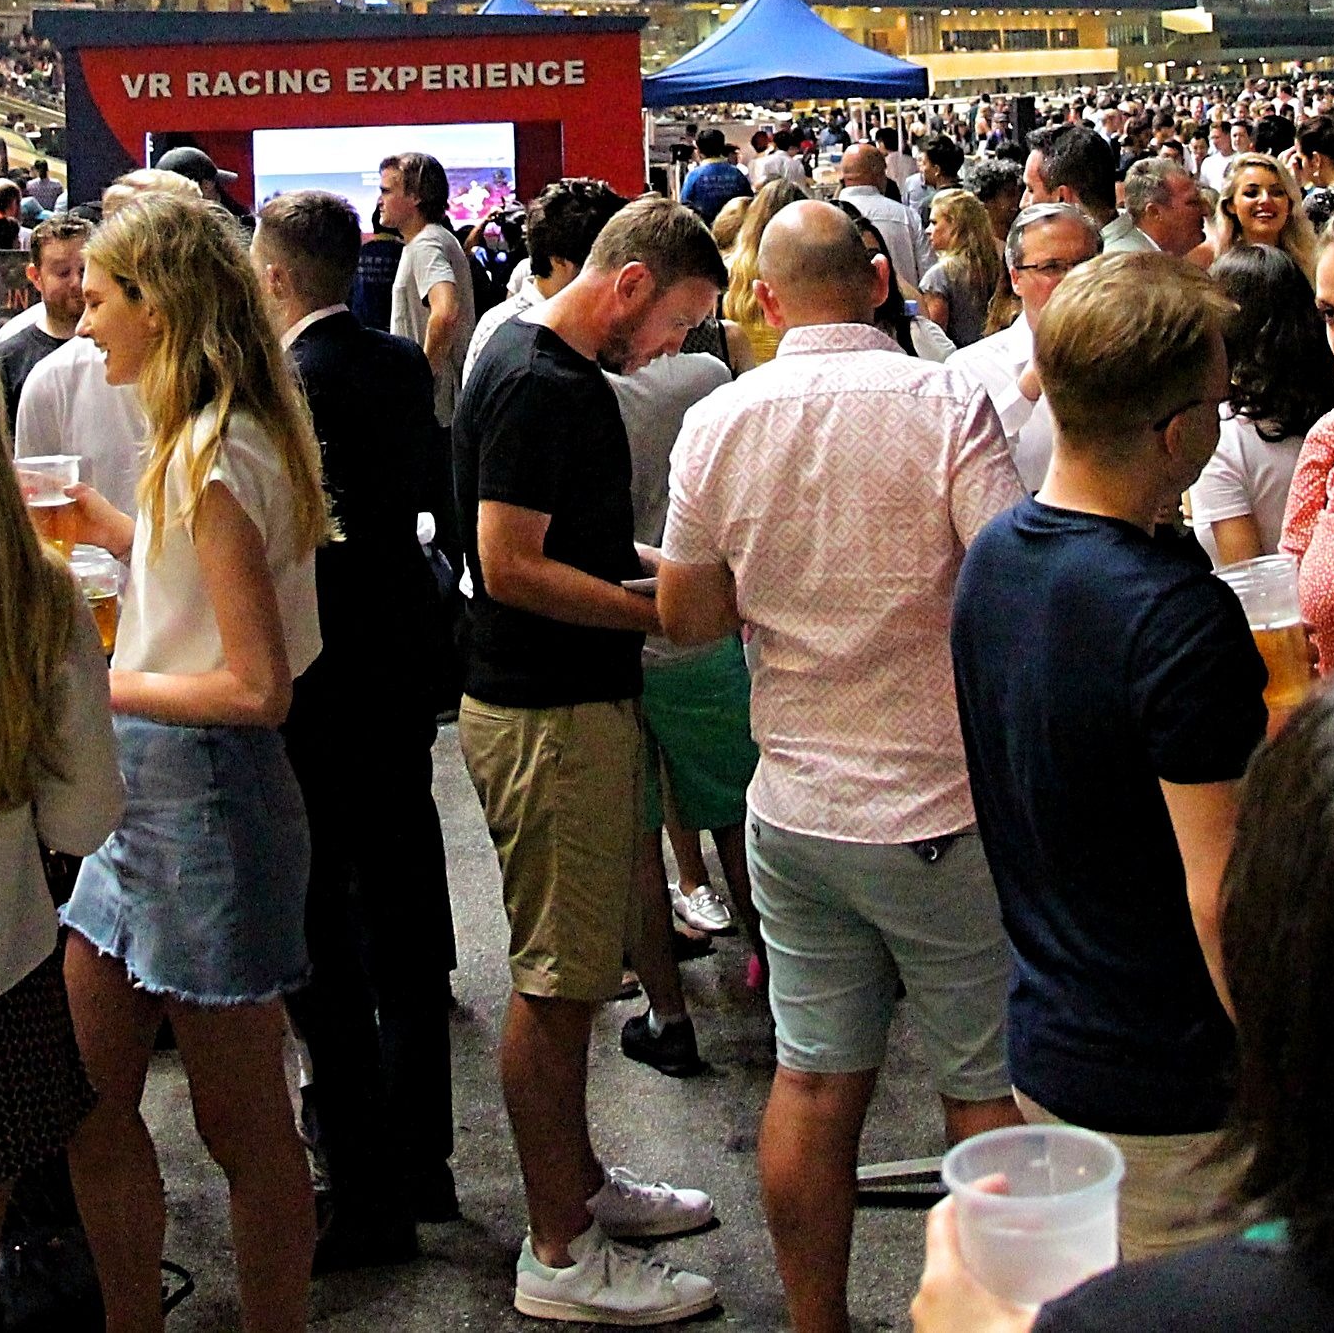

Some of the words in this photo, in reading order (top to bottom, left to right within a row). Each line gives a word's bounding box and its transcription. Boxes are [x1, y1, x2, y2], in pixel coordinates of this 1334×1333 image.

[121, 73, 172, 98] VR
[186, 68, 331, 97] RACING
[346, 59, 586, 92] EXPERIENCE
